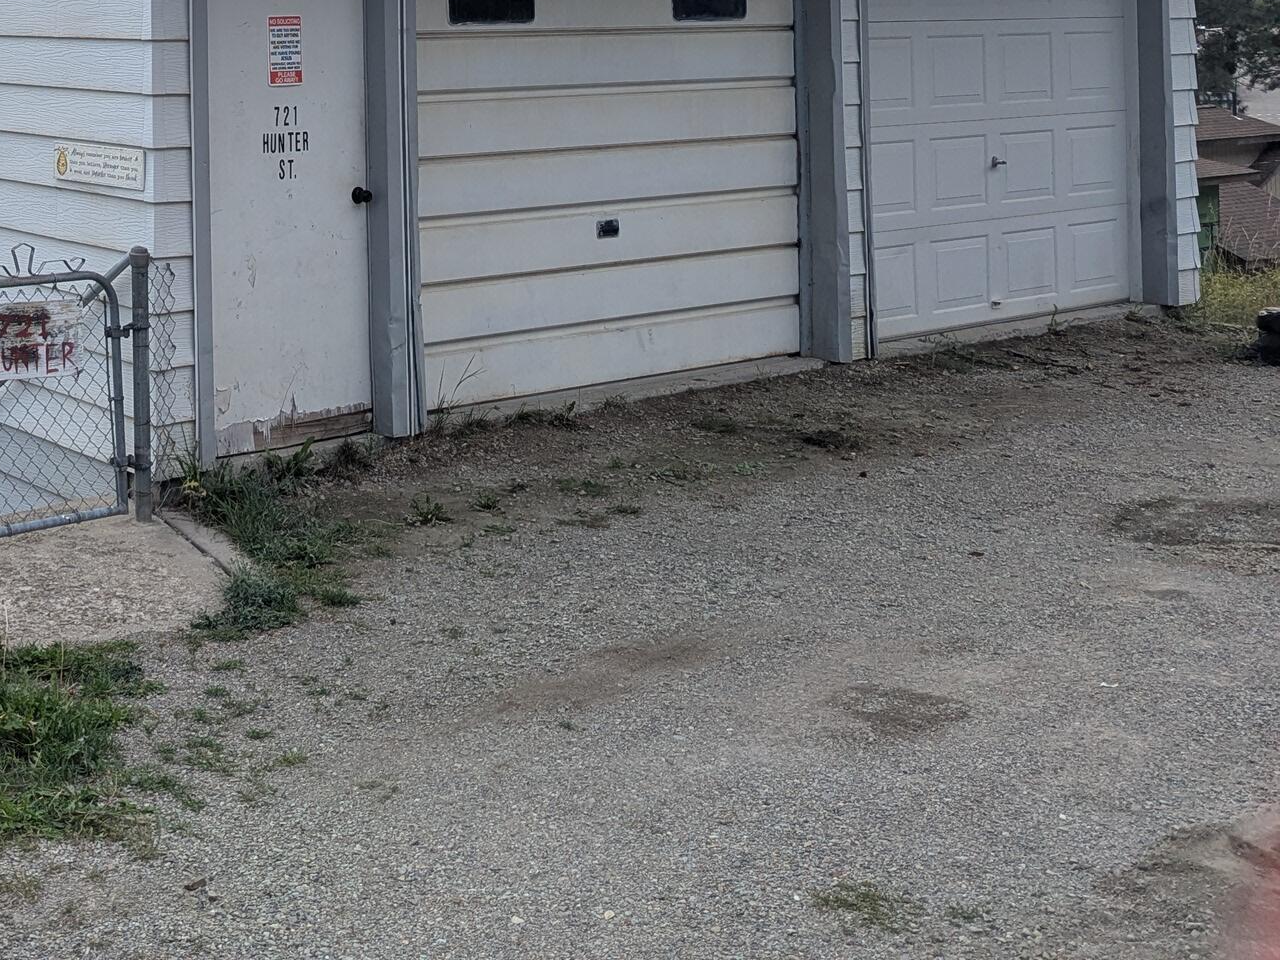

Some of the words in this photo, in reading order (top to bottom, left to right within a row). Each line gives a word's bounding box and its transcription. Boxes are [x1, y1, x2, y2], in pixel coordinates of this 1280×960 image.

[274, 106, 297, 127] 721
[263, 131, 309, 154] HUNTER
[278, 159, 297, 180] ST.
